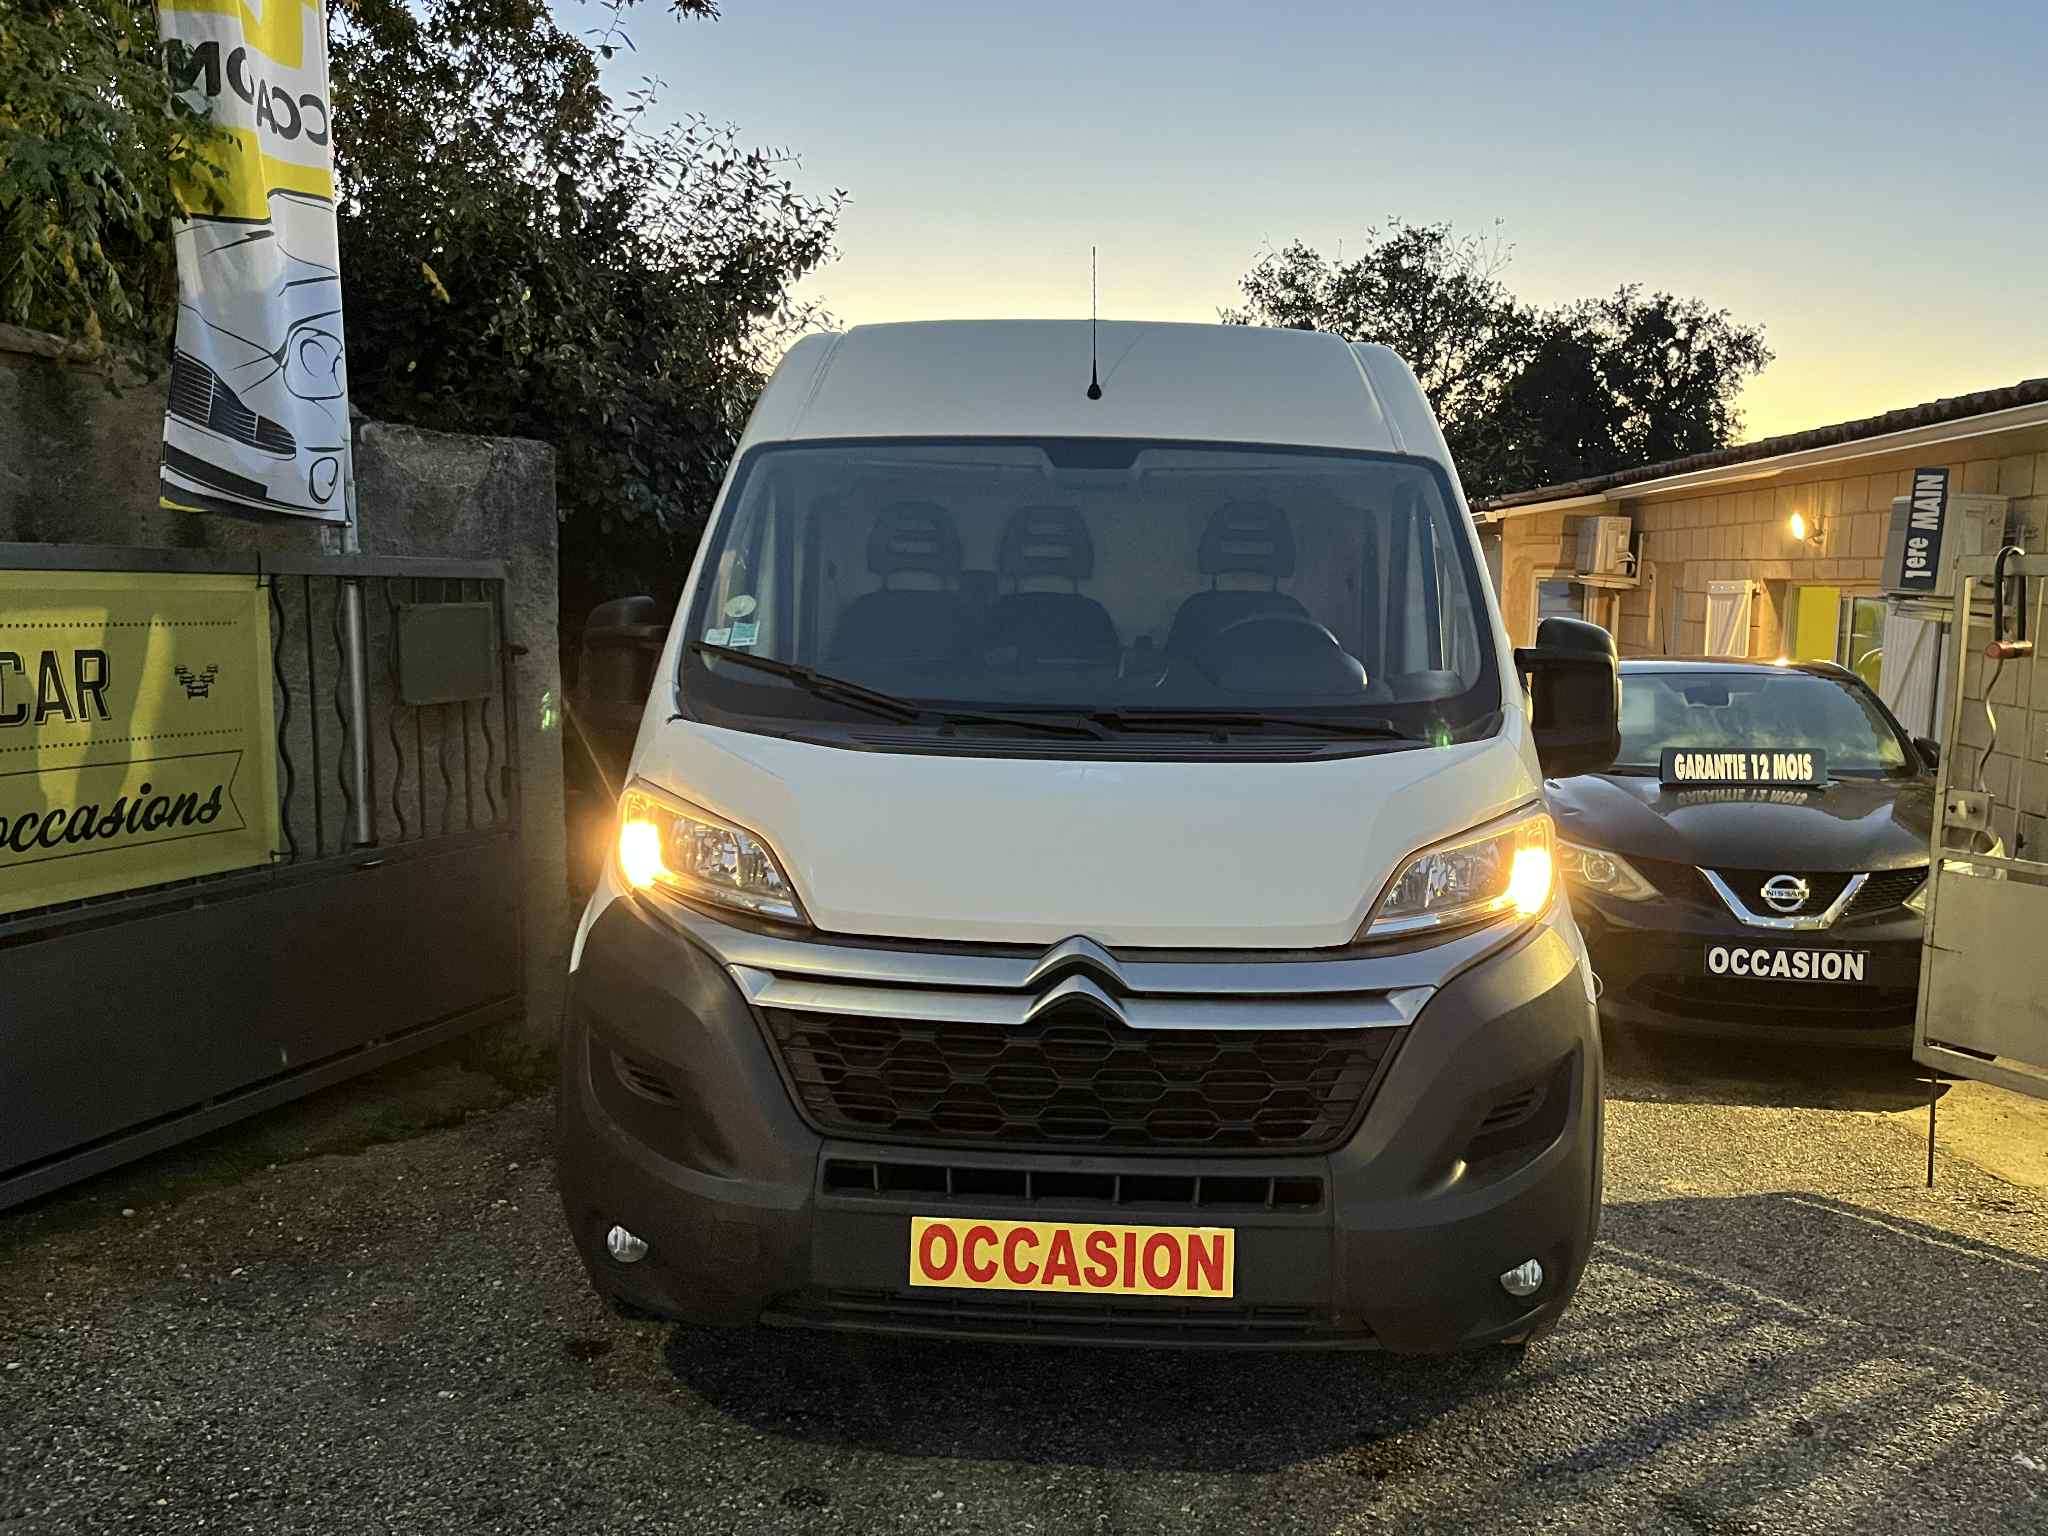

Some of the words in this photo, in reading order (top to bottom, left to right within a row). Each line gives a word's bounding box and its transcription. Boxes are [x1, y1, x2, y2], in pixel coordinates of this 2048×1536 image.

[1911, 474, 1945, 531] MAIN
[1904, 537, 1932, 579] 1ere
[1674, 753, 1747, 780] GARANTIE
[1751, 754, 1769, 780] 12
[1773, 754, 1813, 781] MOIS
[1765, 889, 1806, 898] NISSAN
[1708, 946, 1864, 980] OCCASION
[919, 1223, 1225, 1291] OCCASION
